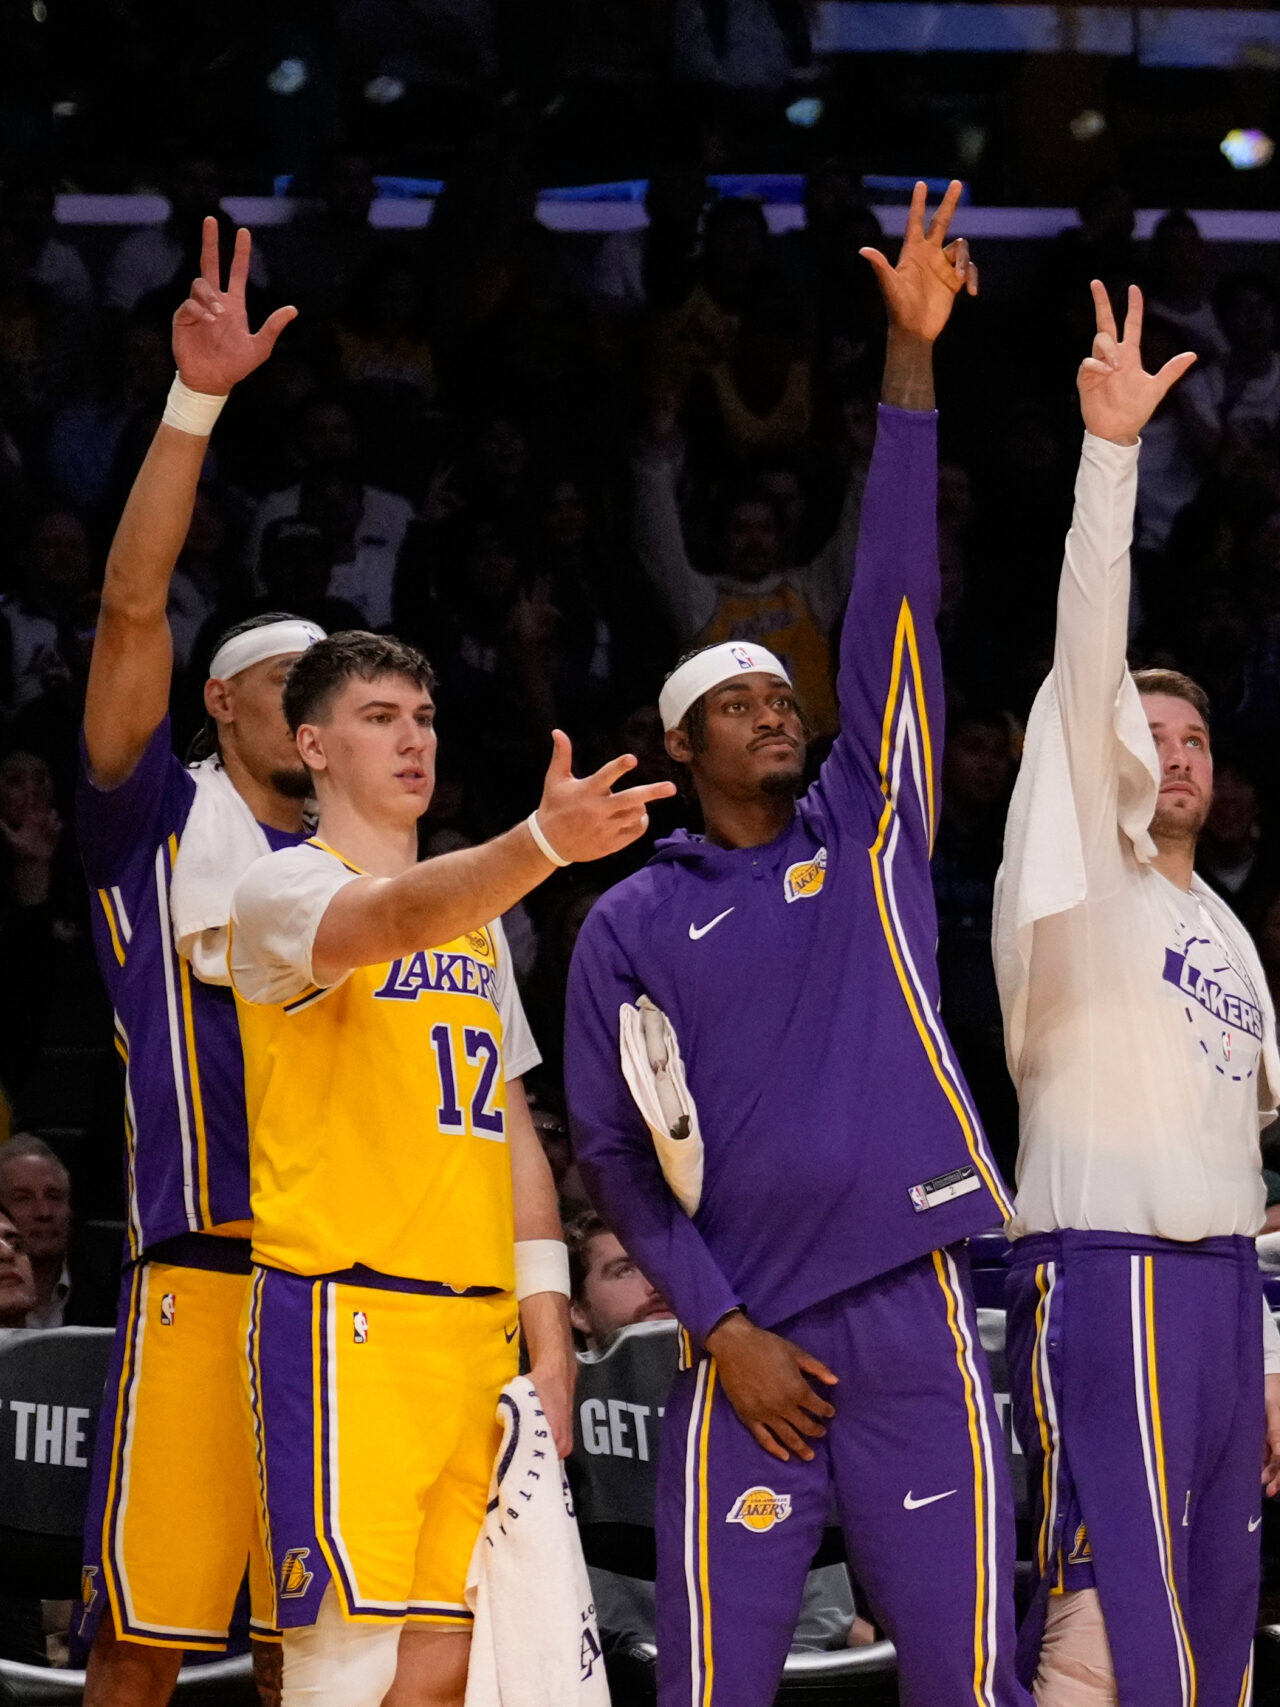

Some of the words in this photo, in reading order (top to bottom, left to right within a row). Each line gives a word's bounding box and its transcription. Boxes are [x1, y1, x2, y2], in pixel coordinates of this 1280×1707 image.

[1174, 950, 1264, 1042] LAKERS
[430, 1021, 506, 1143] 12
[9, 1400, 90, 1468] THE
[579, 1398, 651, 1462] GET
